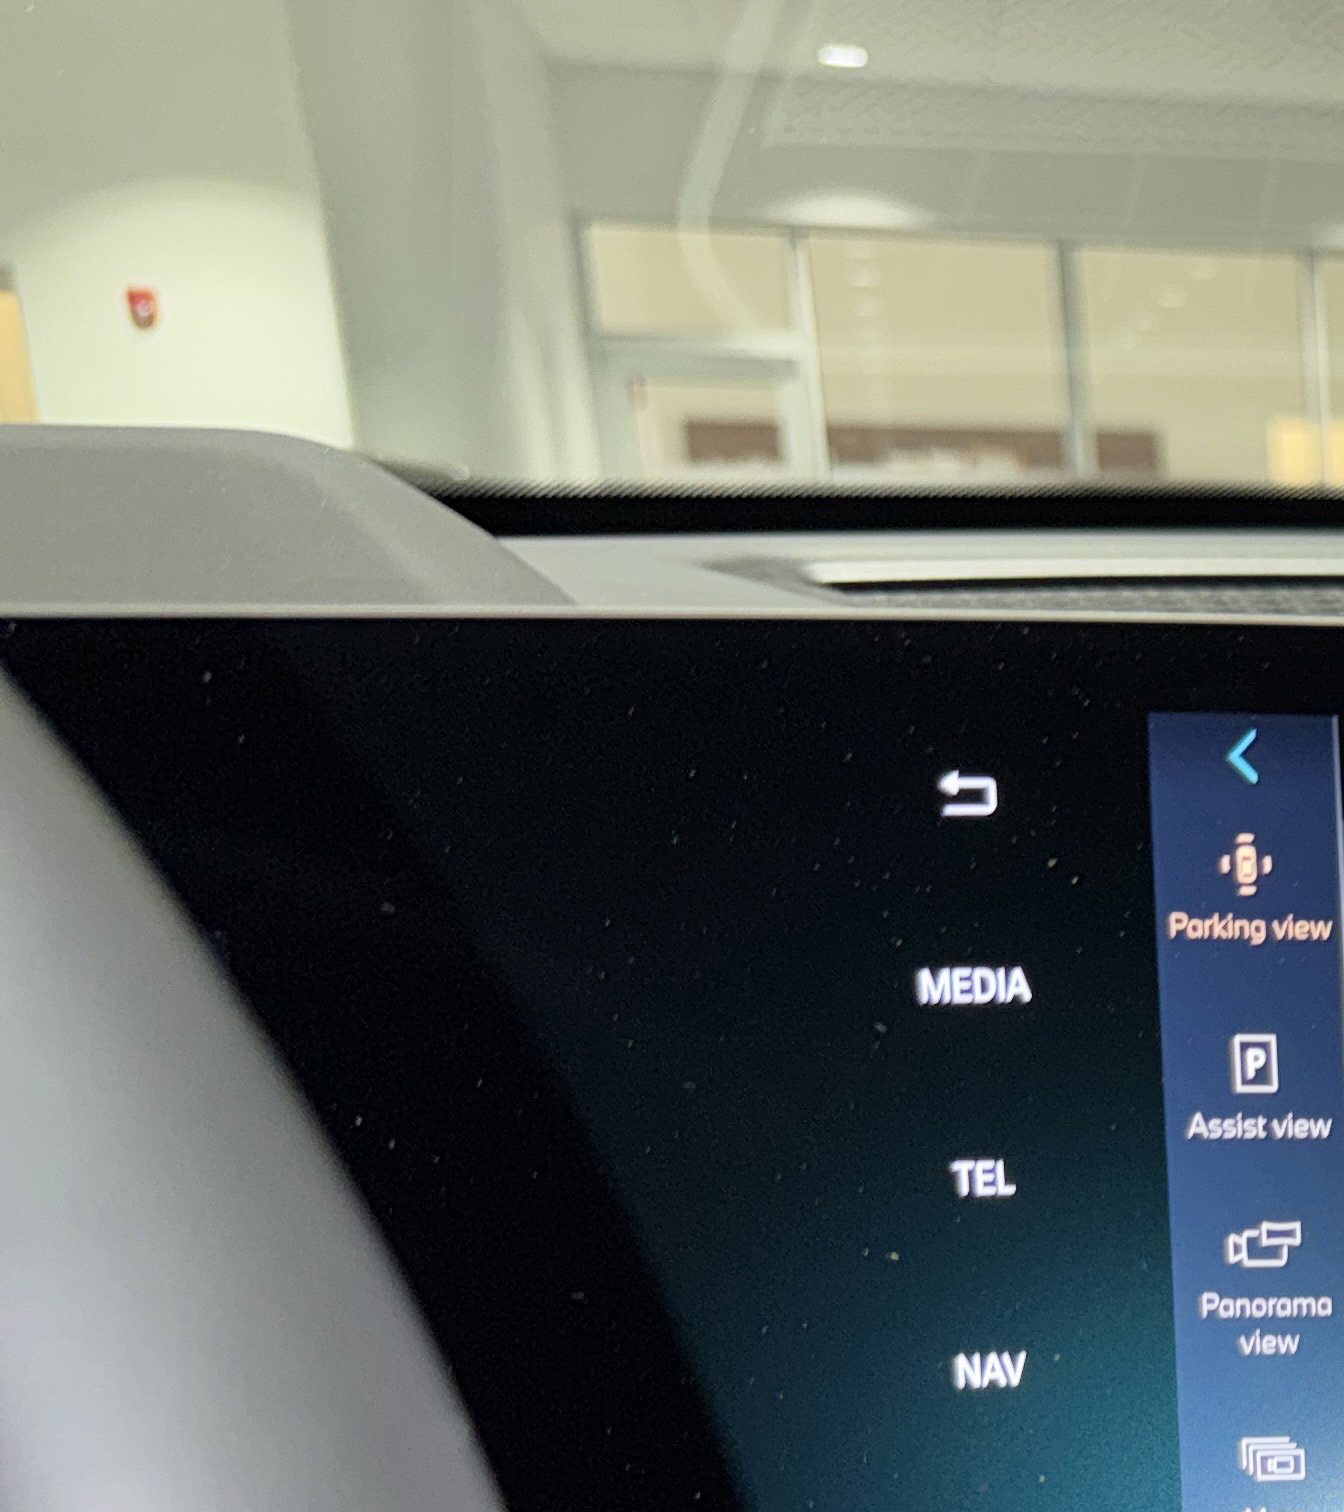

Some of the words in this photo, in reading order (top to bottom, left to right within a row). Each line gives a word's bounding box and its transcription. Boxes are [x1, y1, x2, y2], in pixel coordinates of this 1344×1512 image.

[1168, 911, 1266, 945] Parking
[1273, 914, 1333, 941] view
[915, 964, 1033, 1006] MEDIA
[1186, 1111, 1266, 1140] Assist
[1272, 1113, 1333, 1140] view
[950, 1158, 1017, 1198] TEL
[1200, 1292, 1333, 1320] Panorama
[1240, 1328, 1300, 1357] view
[953, 1350, 1027, 1390] NAV
